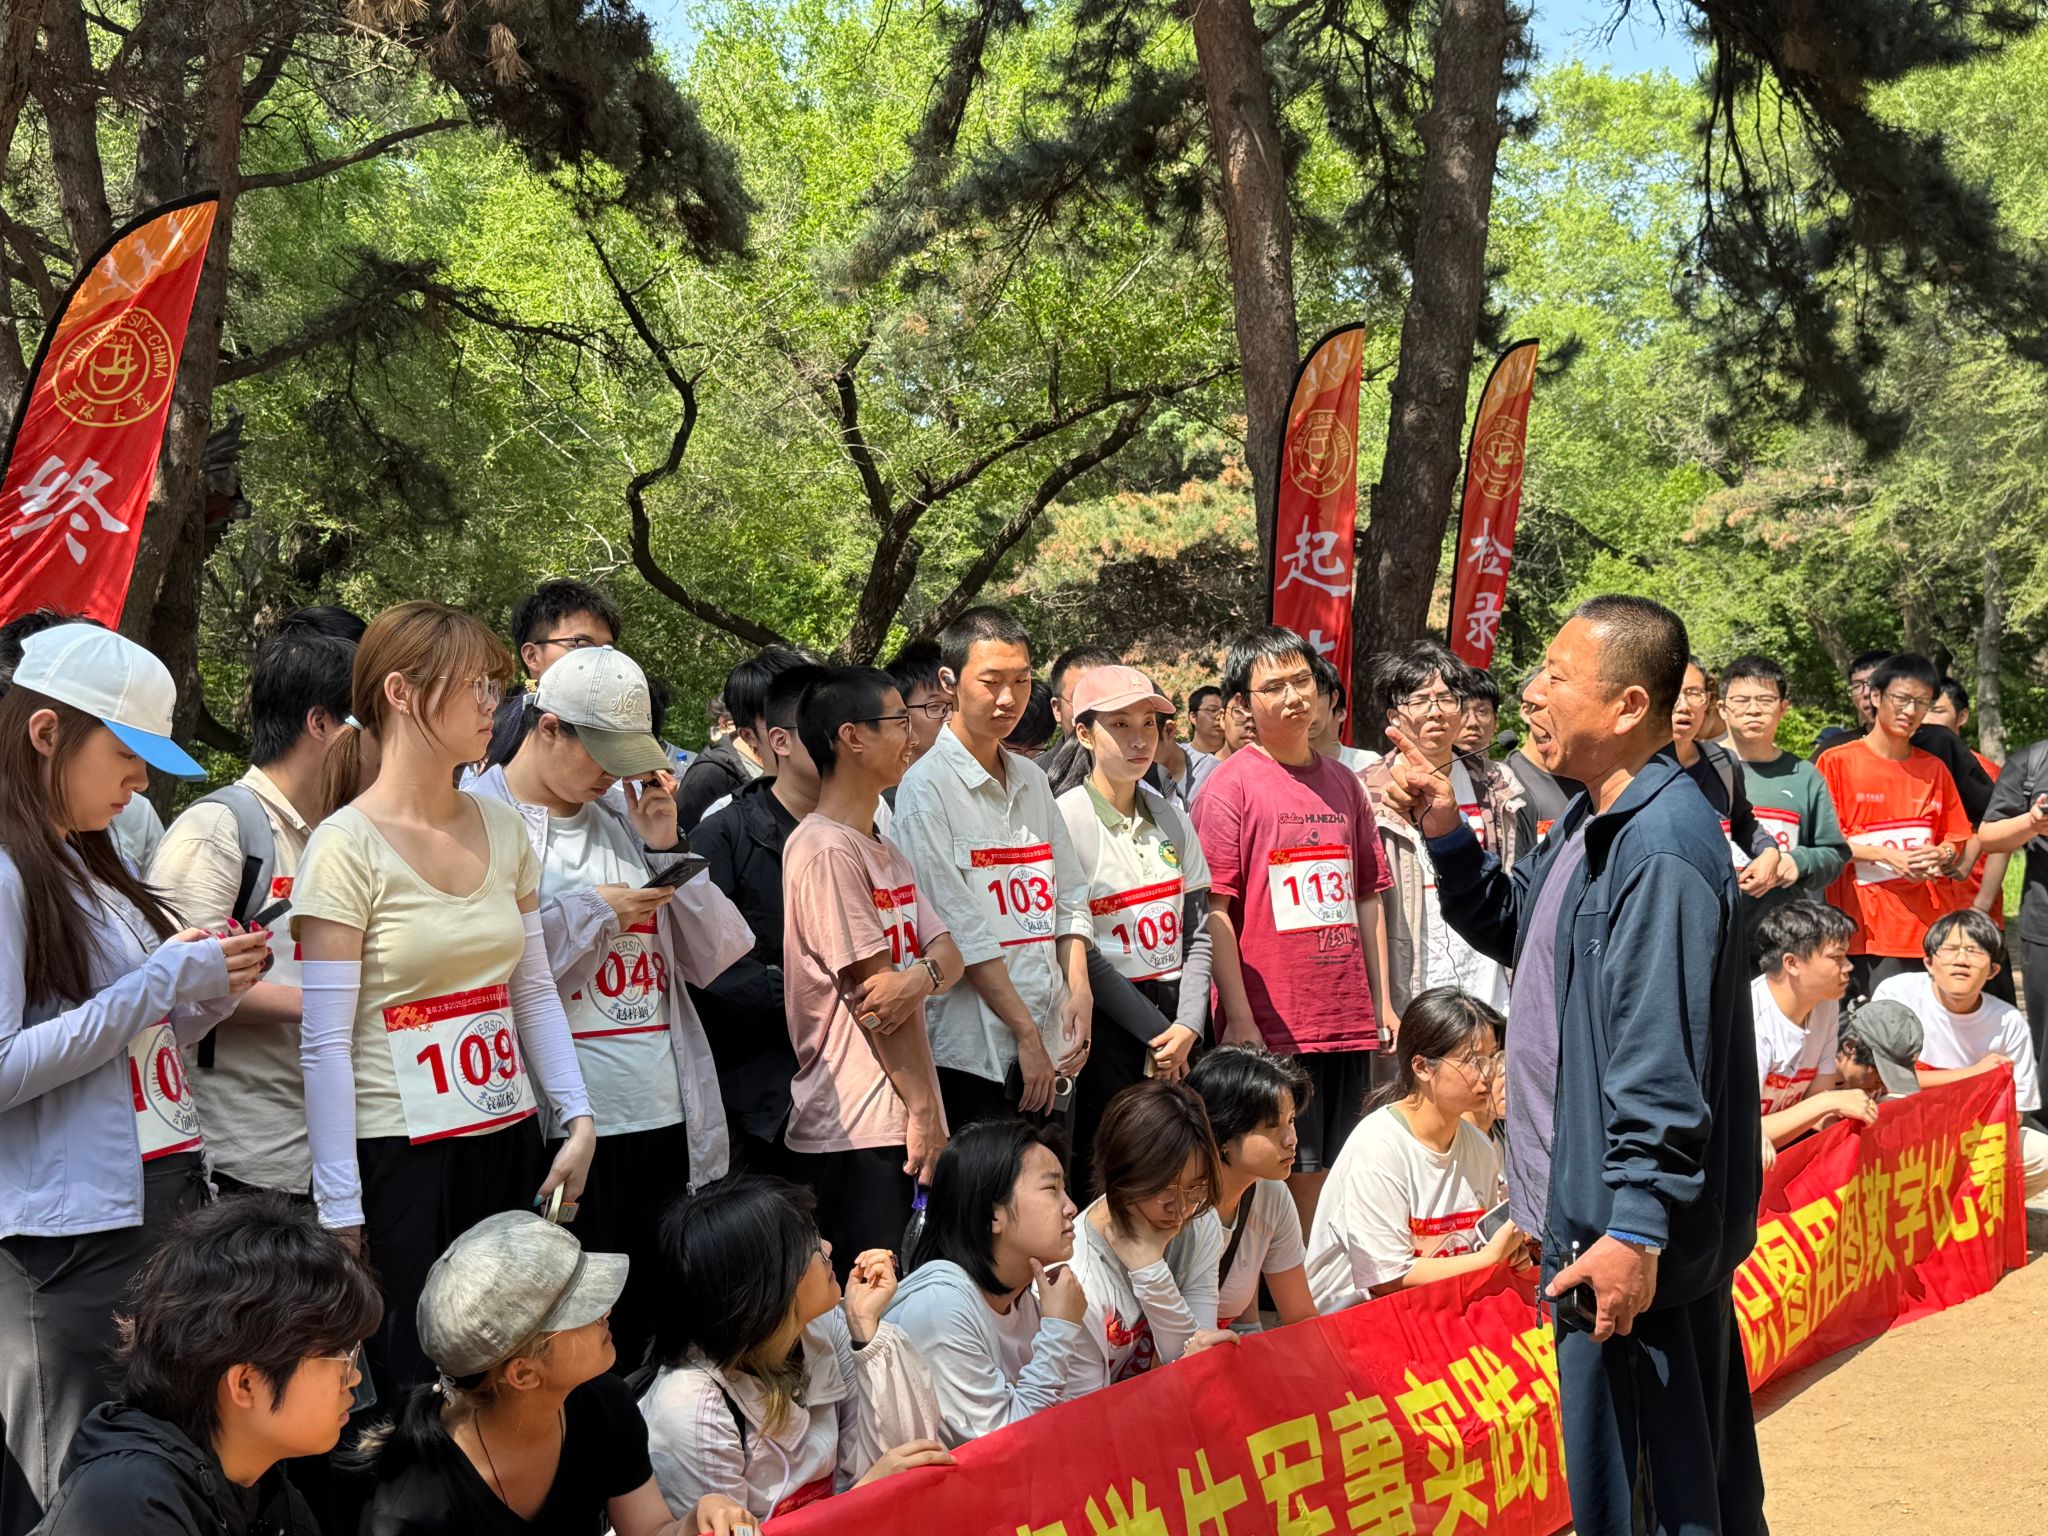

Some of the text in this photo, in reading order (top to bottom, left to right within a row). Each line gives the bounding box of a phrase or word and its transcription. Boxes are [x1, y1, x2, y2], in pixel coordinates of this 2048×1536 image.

[10, 454, 130, 565] 终
[1465, 516, 1513, 650] 检录
[987, 876, 1055, 916] 103
[1283, 871, 1354, 906] 113
[1111, 911, 1184, 955] 109
[571, 951, 669, 1000] 048
[416, 1027, 527, 1095] 109
